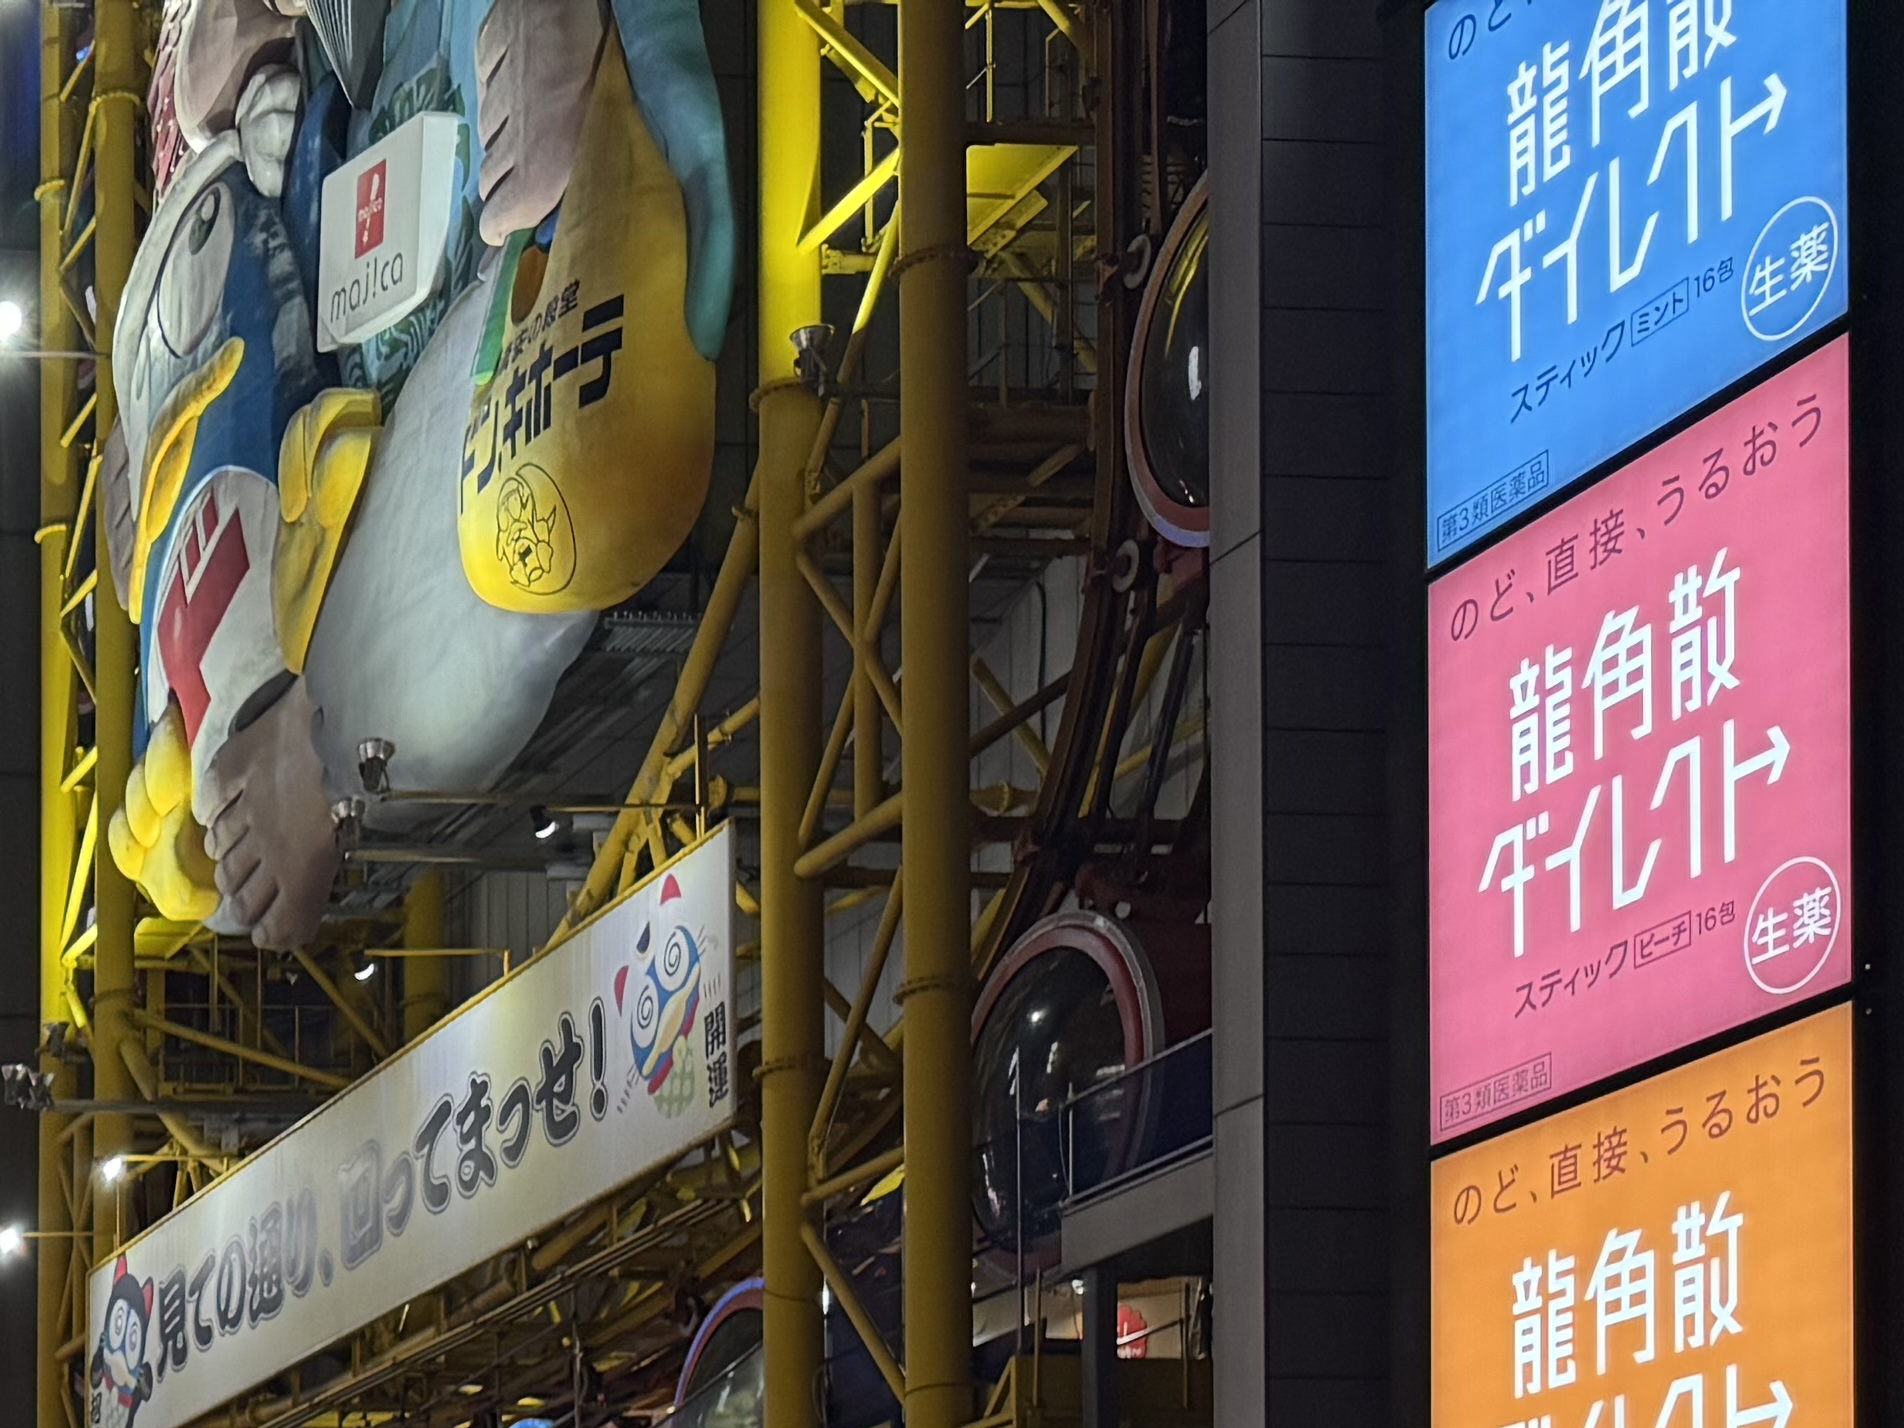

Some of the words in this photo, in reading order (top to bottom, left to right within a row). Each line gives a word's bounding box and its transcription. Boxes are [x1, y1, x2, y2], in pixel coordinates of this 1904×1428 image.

[1475, 73, 1788, 363] ダイレクト
[1749, 221, 1830, 317] 生薬
[1510, 320, 1626, 424] スティック
[1636, 292, 1685, 336] ミント
[1693, 256, 1735, 299] 16包
[1441, 458, 1547, 541] 第3類医薬品
[1451, 394, 1824, 642] のど、直接、うるおう
[1509, 547, 1742, 802] 龍角散
[1478, 718, 1792, 959] ダイレクト
[1513, 940, 1629, 1019] スティック
[1638, 920, 1688, 962] ピーチ
[1695, 901, 1737, 939] 16包
[1751, 888, 1834, 965] 生薬
[1442, 1061, 1549, 1129] 第3類医薬品
[1453, 1055, 1827, 1227] のど、直接、うるおう
[1511, 1190, 1744, 1400] 龍角散
